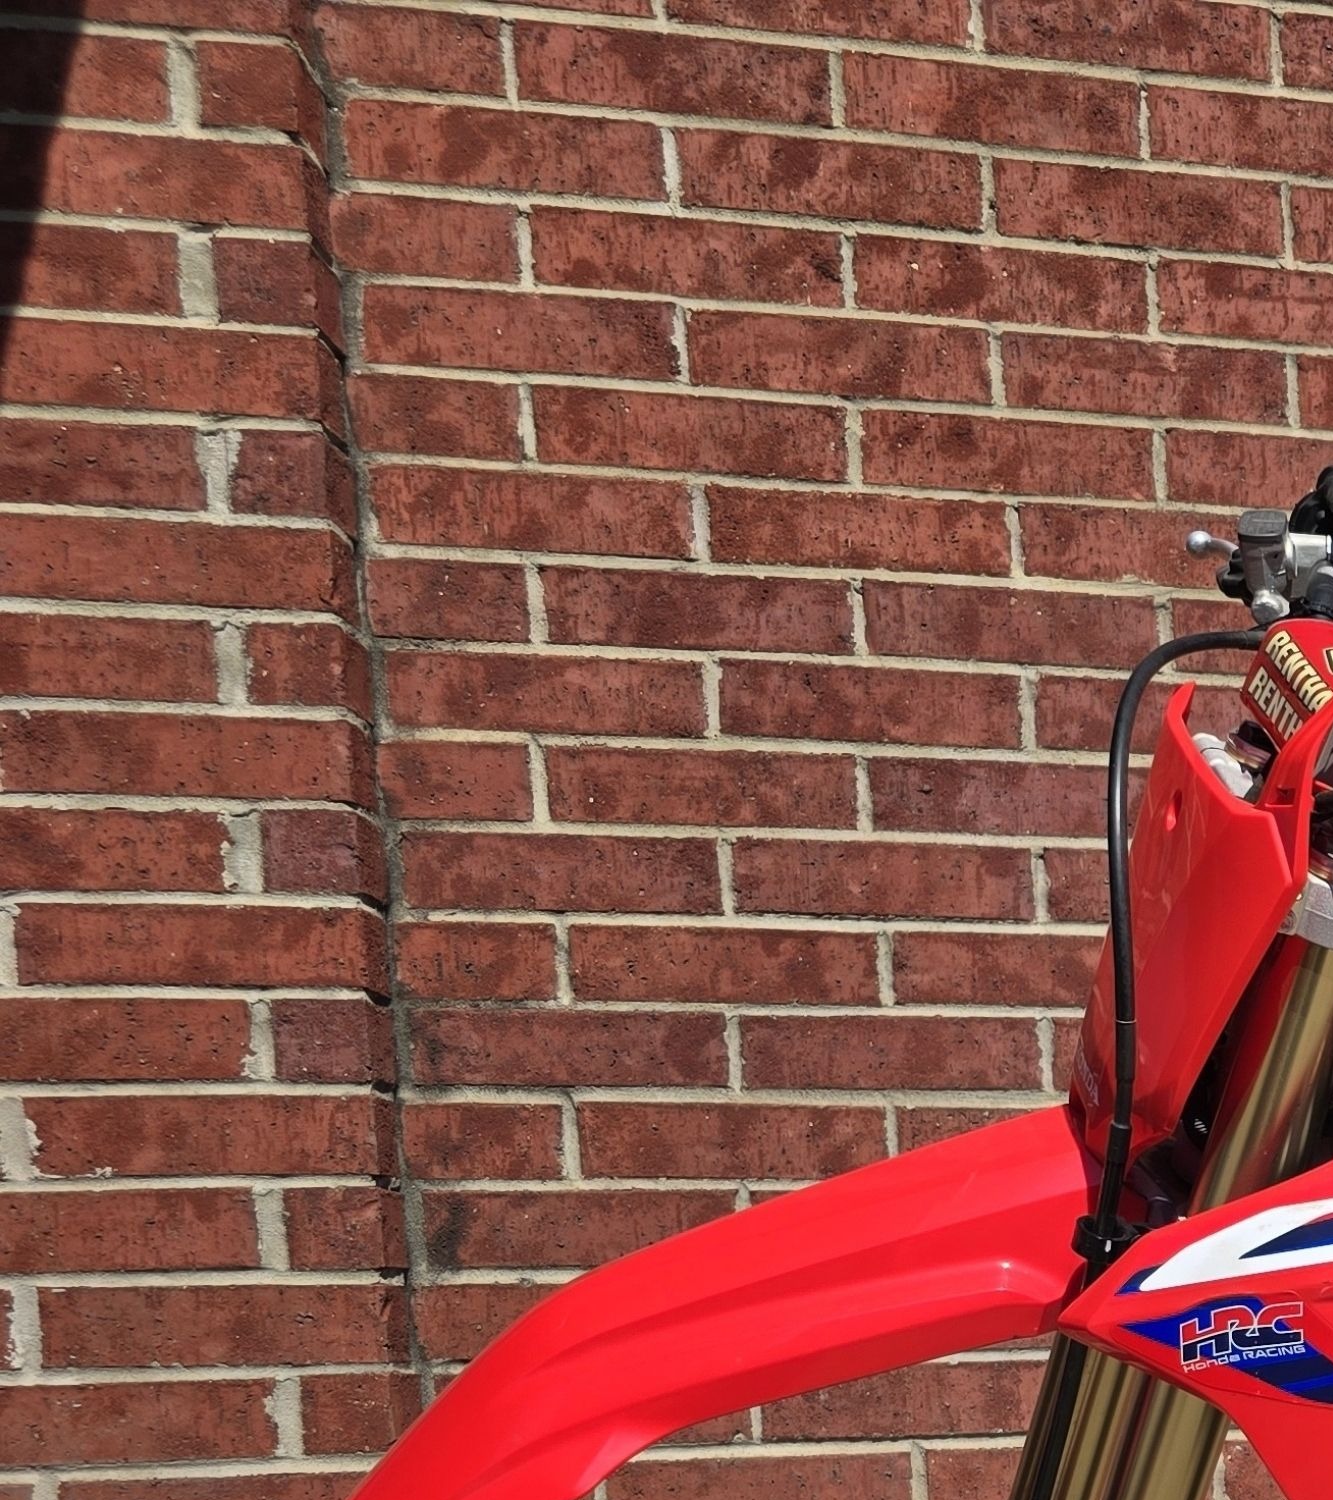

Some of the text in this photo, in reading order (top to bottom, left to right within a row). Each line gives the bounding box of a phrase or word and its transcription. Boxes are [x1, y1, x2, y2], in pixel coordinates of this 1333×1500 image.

[1247, 666, 1304, 741] RENTH
[1179, 1301, 1304, 1366] HRC
[1242, 1344, 1306, 1361] RACING
